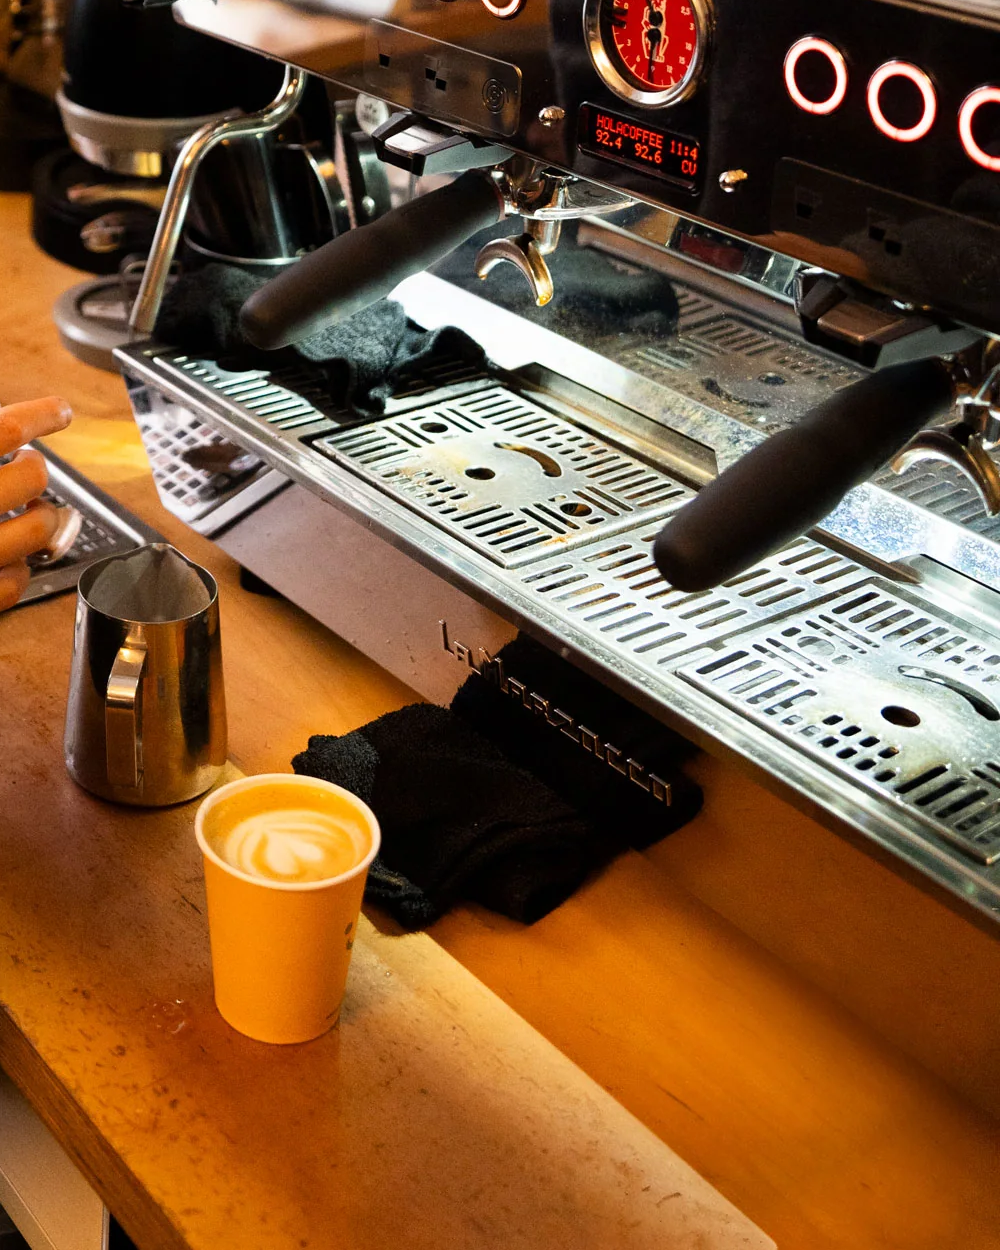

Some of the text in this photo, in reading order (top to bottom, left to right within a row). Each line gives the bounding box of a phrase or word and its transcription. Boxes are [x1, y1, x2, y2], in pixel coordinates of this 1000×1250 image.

[680, 5, 691, 16] 2,5
[596, 113, 664, 149] HOLACOFFEE
[596, 129, 622, 149] 92.4
[634, 143, 663, 164] 92.6
